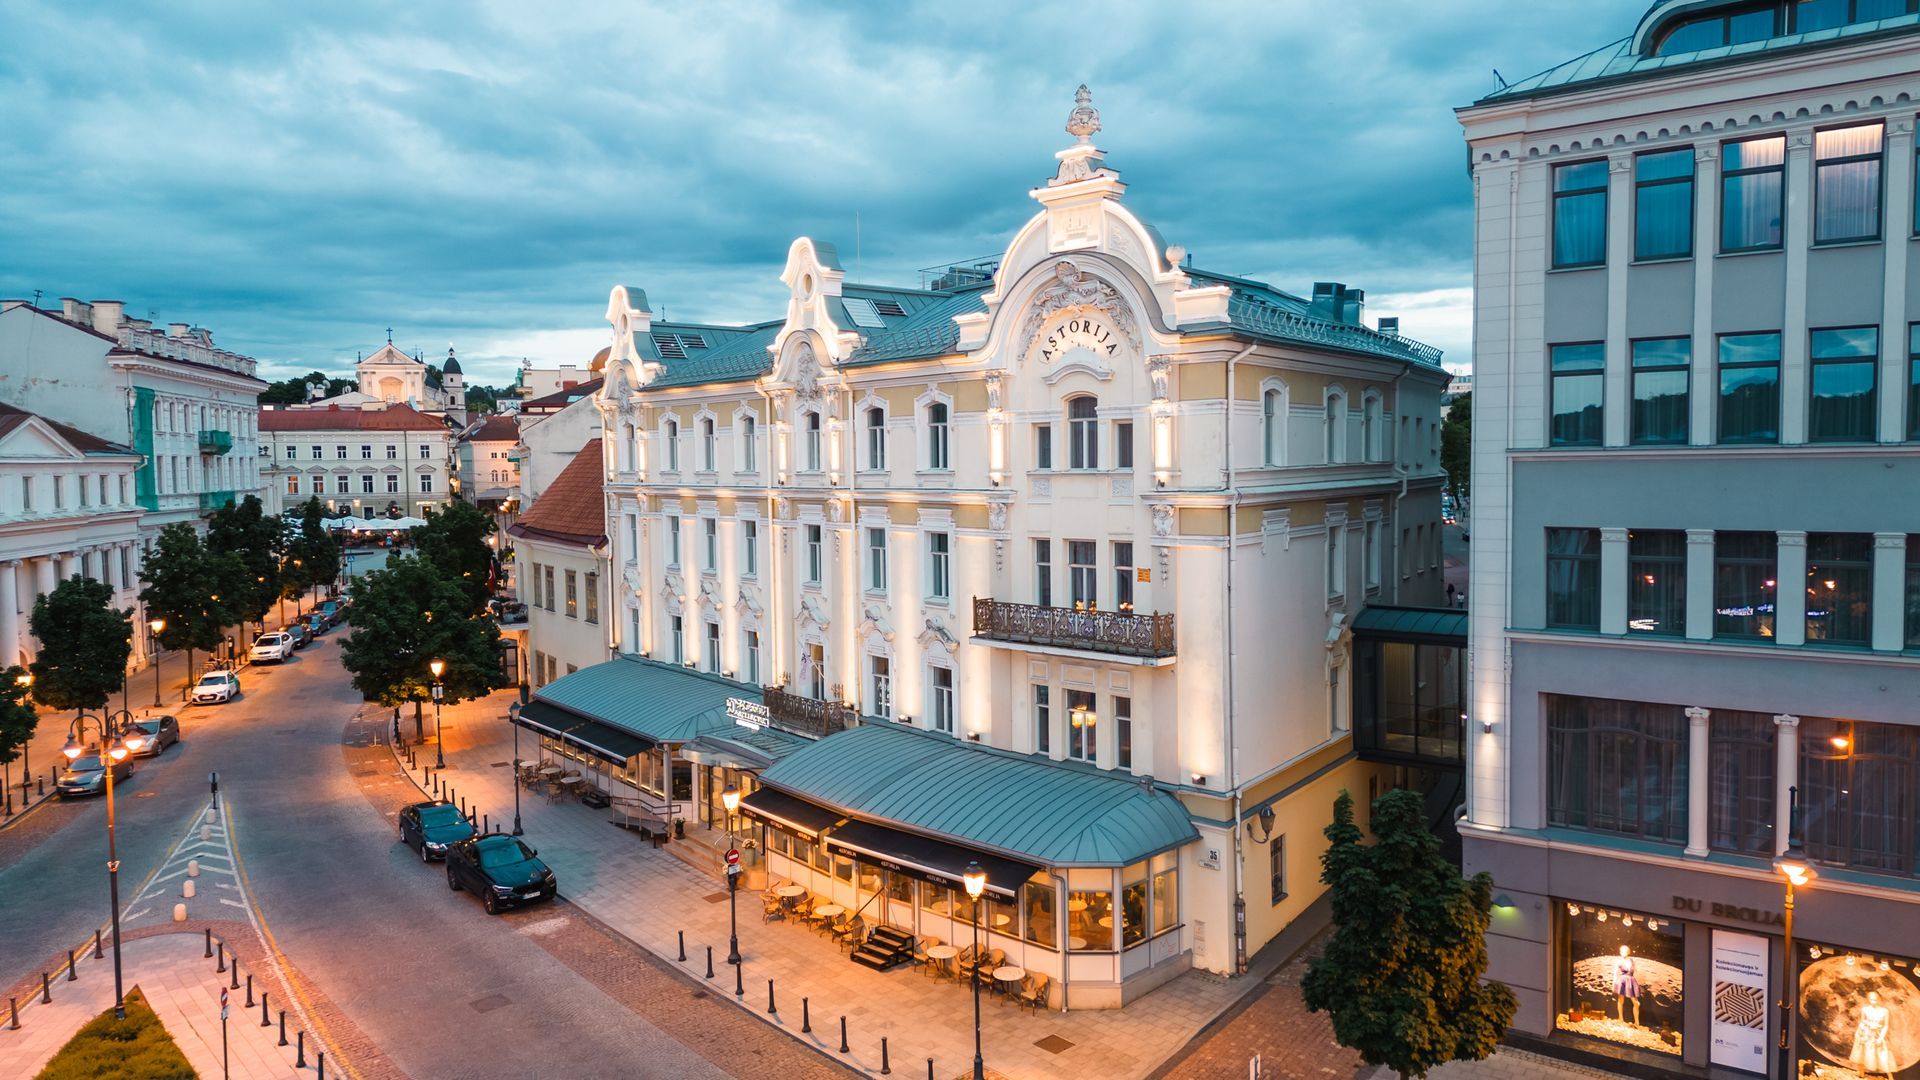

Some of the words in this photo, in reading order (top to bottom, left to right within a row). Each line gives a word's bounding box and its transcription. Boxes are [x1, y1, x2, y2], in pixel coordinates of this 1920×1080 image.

[1042, 320, 1117, 361] ASTORIJA
[1209, 850, 1218, 860] 35
[1672, 895, 1702, 913] DU
[1711, 901, 1786, 927] BROLIA
